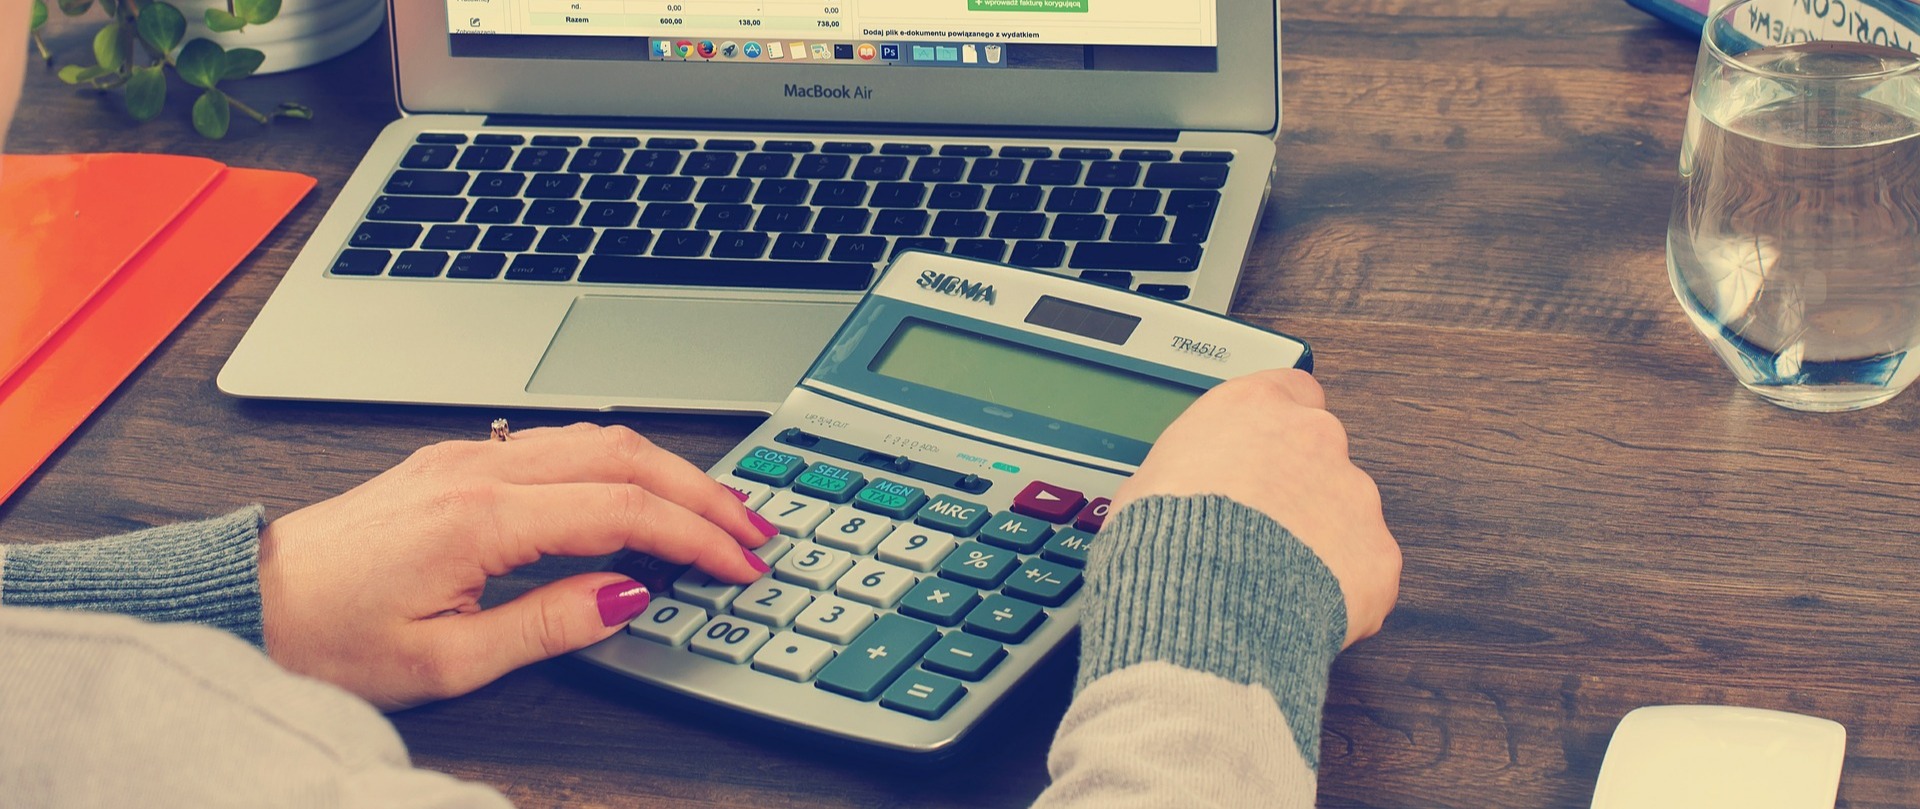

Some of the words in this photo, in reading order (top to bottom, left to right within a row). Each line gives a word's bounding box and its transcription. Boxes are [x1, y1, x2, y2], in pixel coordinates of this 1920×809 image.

[660, 18, 683, 26] 600,00
[738, 19, 761, 27] 138,00
[817, 20, 840, 28] 738,00
[863, 29, 884, 37] Dodaj
[884, 47, 895, 56] Ps
[784, 84, 851, 98] MacBook
[854, 86, 873, 99] Air
[546, 179, 561, 188] W
[605, 182, 614, 190] E
[661, 183, 671, 191] R
[488, 205, 499, 214] A
[546, 206, 556, 214] S
[718, 211, 729, 219] G
[776, 213, 789, 221] H
[501, 232, 513, 241] Z
[558, 233, 570, 242] X
[618, 236, 629, 244] C
[677, 237, 687, 245] V
[734, 239, 744, 247] B
[792, 241, 805, 249] N
[850, 243, 865, 251] M
[512, 266, 534, 274] cmd
[916, 270, 994, 302] SIGMA
[1171, 336, 1226, 358] TR4512
[754, 449, 798, 465] COST
[749, 460, 782, 473] SET
[814, 464, 850, 481] SELL
[804, 473, 842, 489] TAX+
[876, 481, 914, 497] MGN
[866, 491, 901, 506] TAX-
[779, 501, 807, 517] 7
[928, 500, 976, 520] MRC
[840, 517, 866, 534] 8
[999, 519, 1028, 534] M-
[905, 534, 928, 550] 9
[1060, 535, 1091, 551] M+
[798, 549, 826, 567] 5
[963, 551, 994, 569] %
[862, 571, 886, 587] 6
[1025, 568, 1061, 585] +/-
[755, 588, 782, 607] 2
[653, 606, 679, 623] 0
[819, 606, 845, 623] 3
[707, 622, 750, 644] 00
